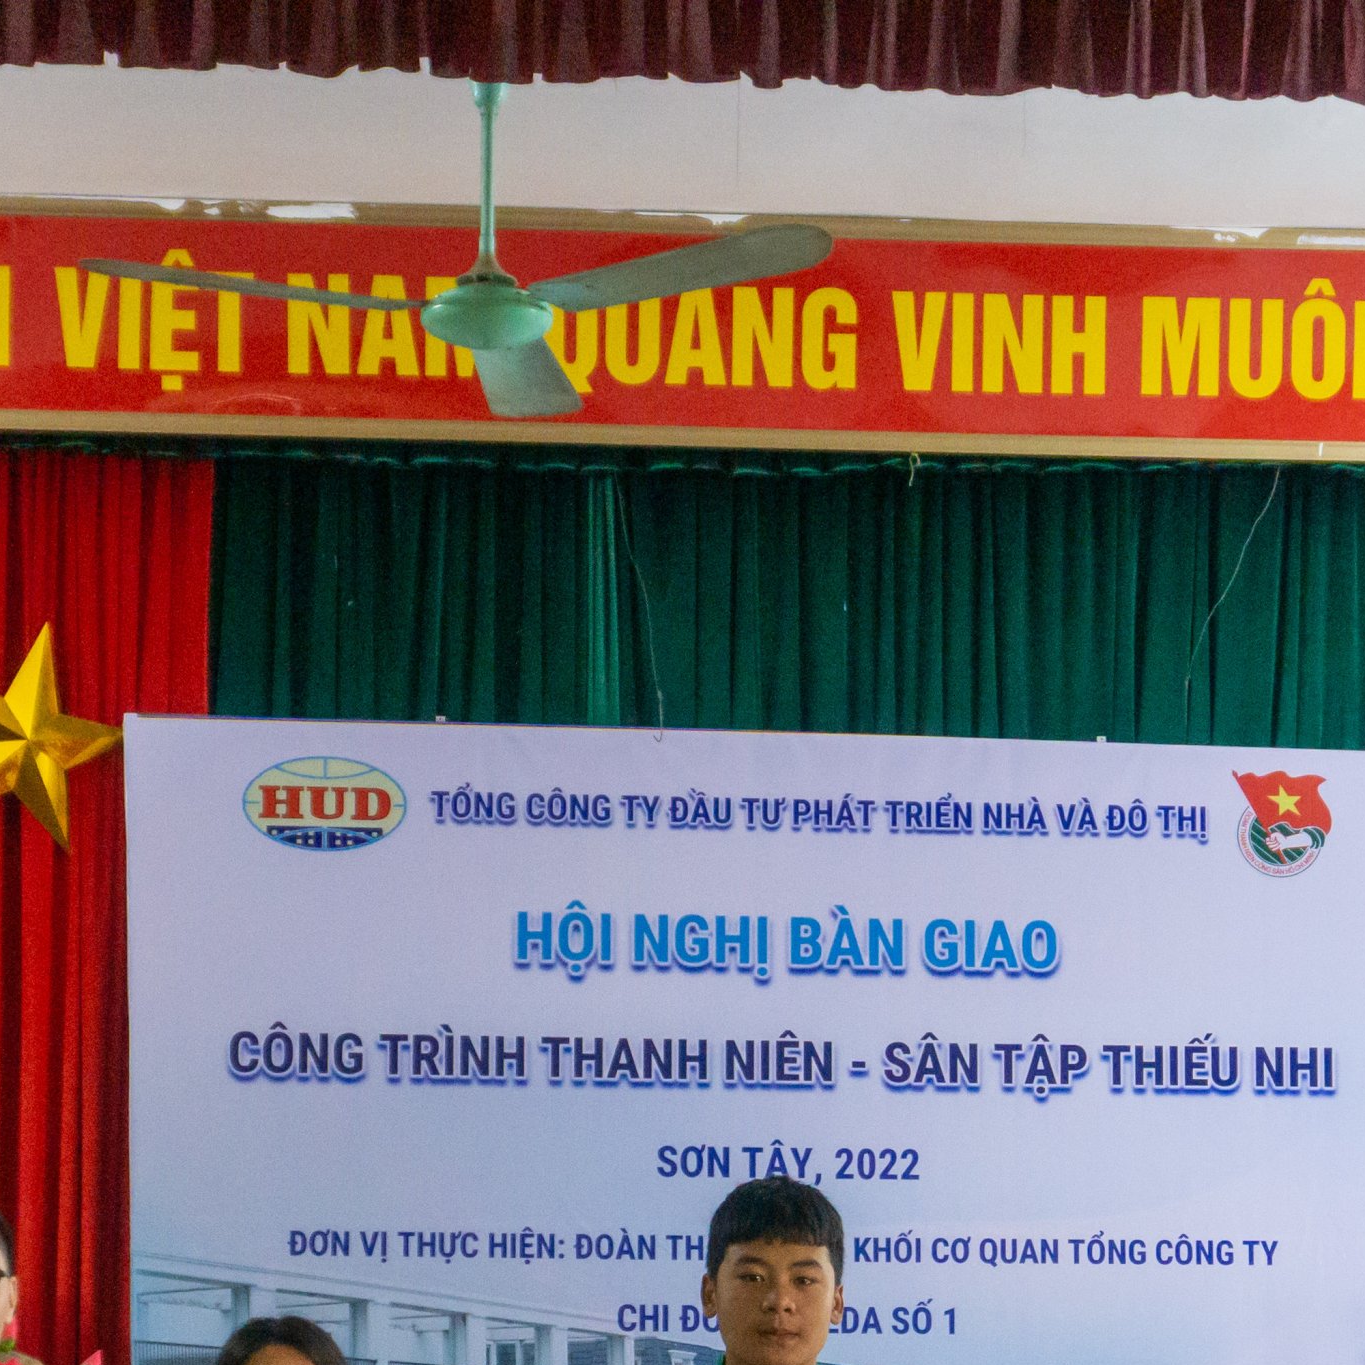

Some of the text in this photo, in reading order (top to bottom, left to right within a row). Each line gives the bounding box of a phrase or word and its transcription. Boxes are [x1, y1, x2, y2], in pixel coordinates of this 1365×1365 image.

[53, 250, 252, 392] VIỆT
[892, 290, 1109, 396] VINH
[258, 784, 392, 820] HUD
[431, 782, 1208, 840] TỔNG CÔNG TY ĐẦU TƯ PHÁT TRIỂN NHÀ VÀ ĐÔ THỊ
[516, 901, 1058, 977] HỘI NGHỊ BÀN GIAO
[229, 1022, 365, 1076] CÔNG
[379, 1024, 525, 1078] TRÌNH
[541, 1036, 708, 1081] THANH
[726, 1030, 833, 1083] NIÊN
[884, 1033, 979, 1084] SÂN
[994, 1034, 1089, 1095] TẬP
[1102, 1033, 1237, 1088] THIẾU
[1255, 1047, 1334, 1088] NHI
[657, 1143, 730, 1179] SƠN
[835, 1148, 920, 1181] 2022
[287, 1230, 350, 1257] ĐƠN
[360, 1231, 389, 1264] VỊ
[397, 1230, 479, 1265] THỰC
[488, 1226, 566, 1265] HIỆN:
[574, 1229, 657, 1261] ĐOÀN
[854, 1230, 922, 1264] KHỐI
[931, 1236, 972, 1265] CƠ
[979, 1238, 1059, 1267] QUAN
[1068, 1230, 1147, 1266] TỔNG
[1155, 1234, 1234, 1266] CÔNG
[1242, 1240, 1279, 1266] TY
[618, 1304, 669, 1332] CHI
[891, 1298, 933, 1335] SỐ
[944, 1308, 955, 1334] 1
